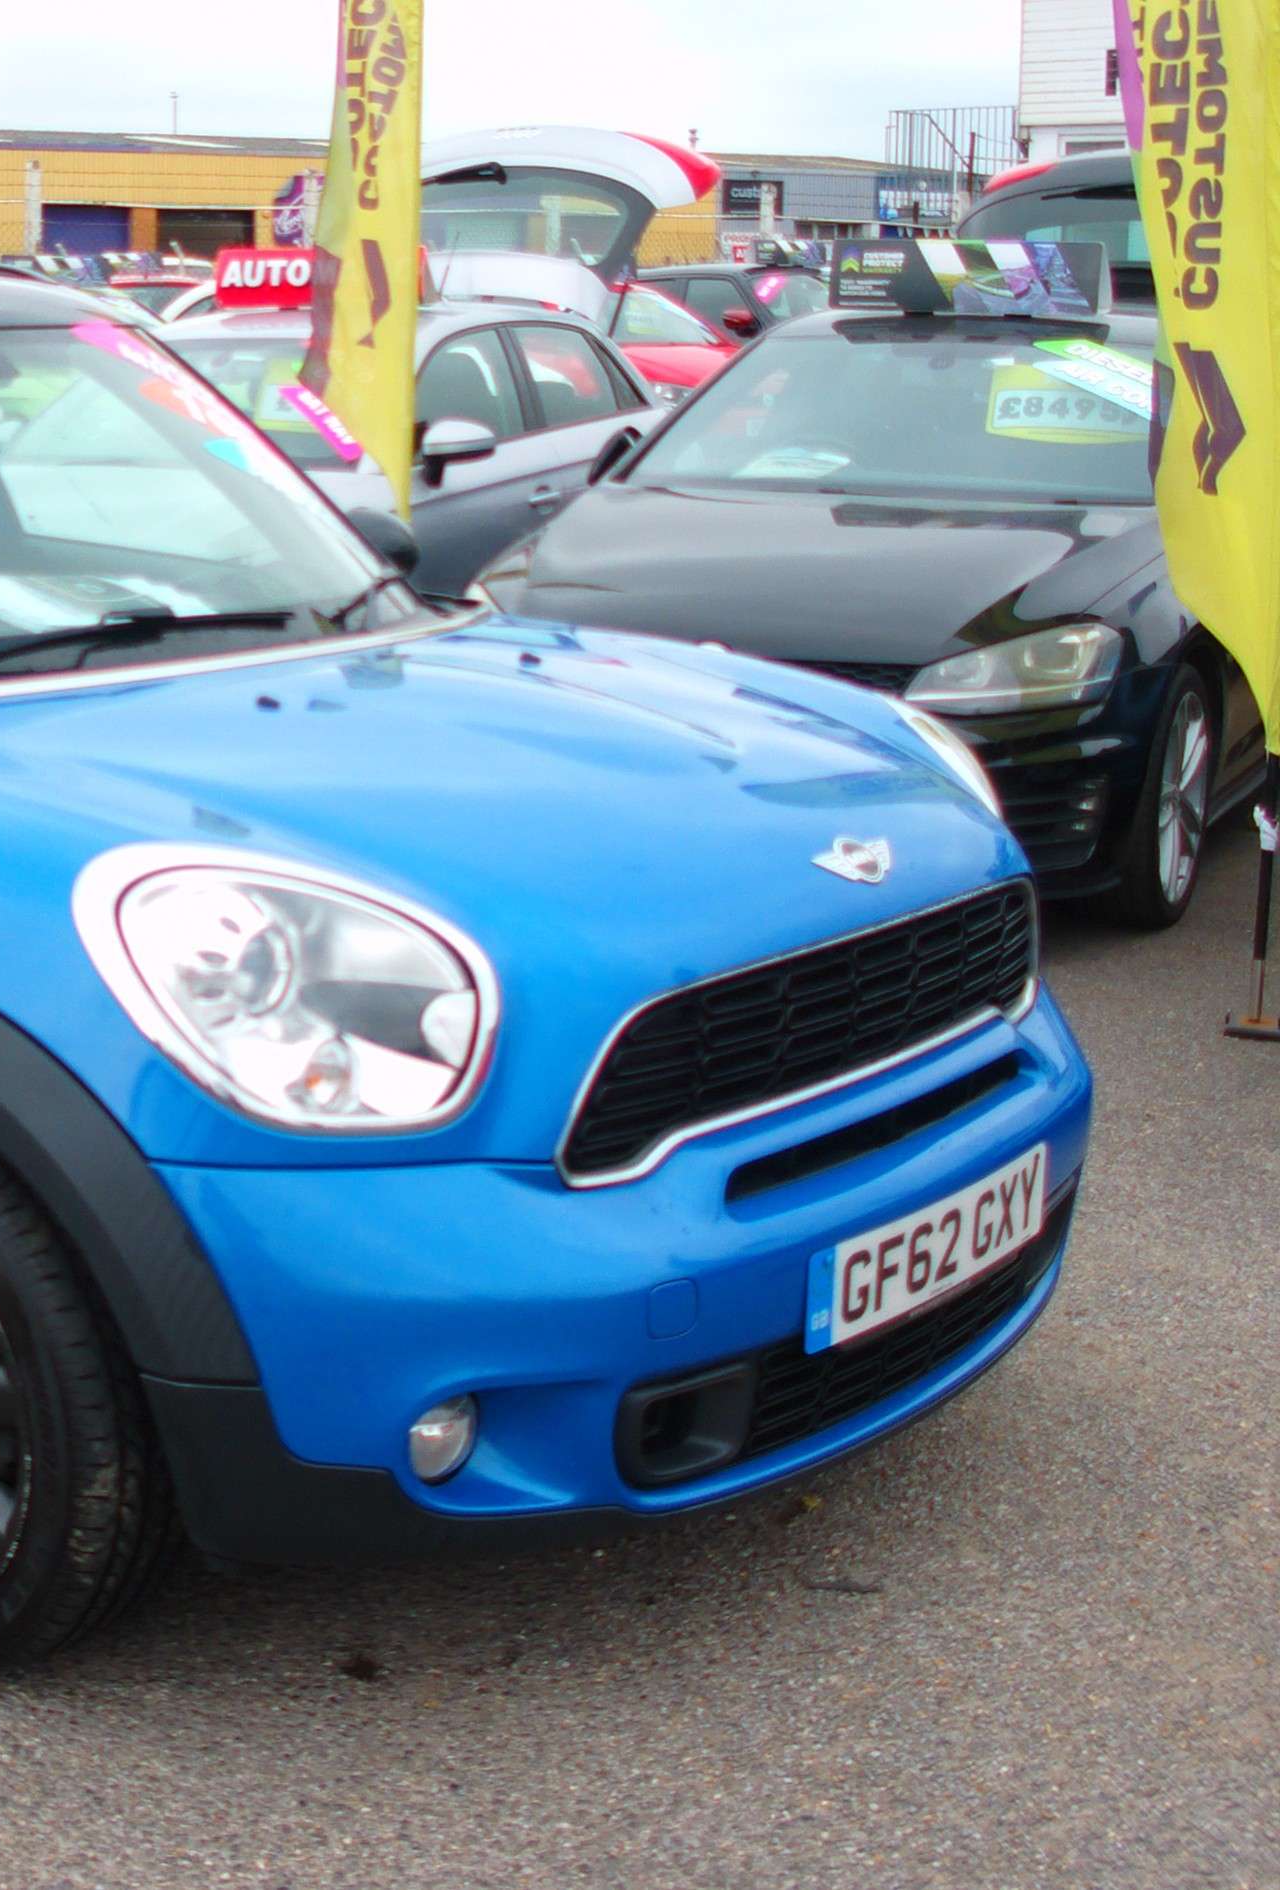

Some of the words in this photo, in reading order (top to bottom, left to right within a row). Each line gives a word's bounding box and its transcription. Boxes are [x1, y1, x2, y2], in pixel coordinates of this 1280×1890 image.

[730, 186, 762, 198] cust
[221, 258, 312, 288] AUTO
[841, 1208, 962, 1324] GF62
[972, 1153, 1040, 1260] GXY
